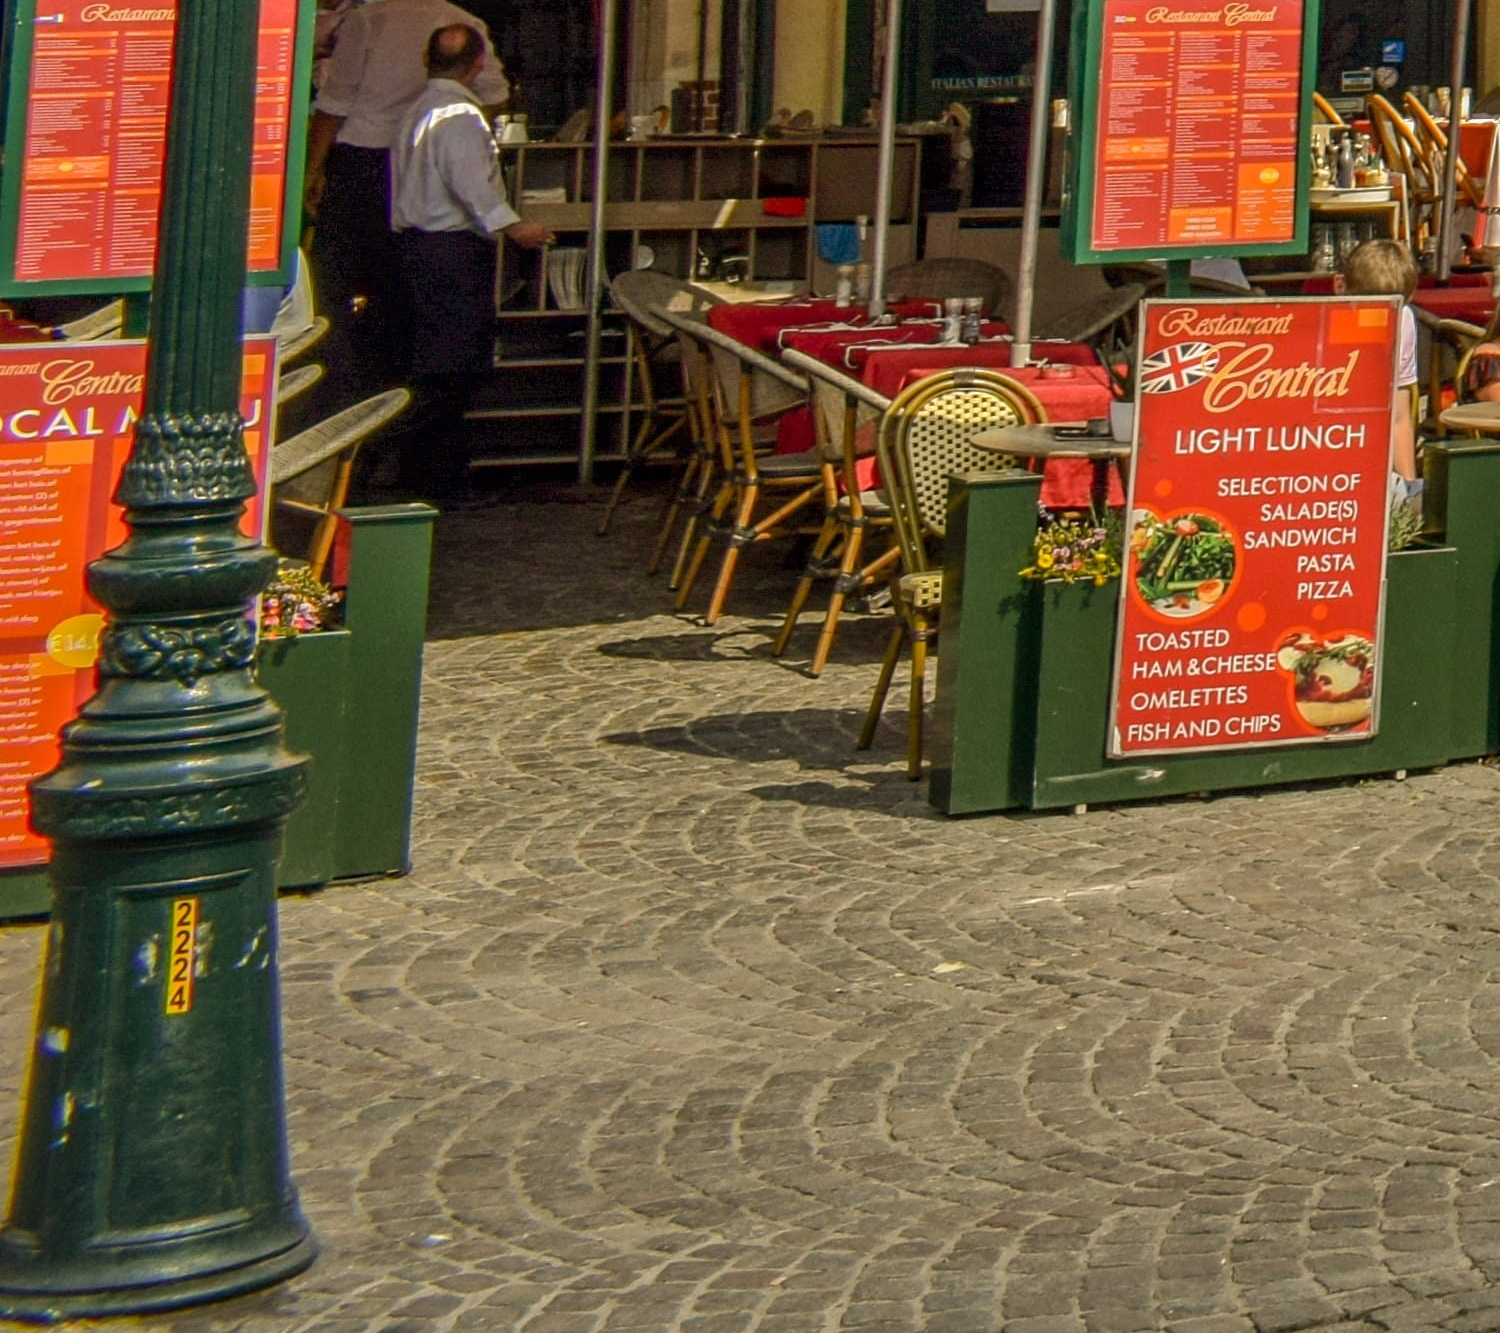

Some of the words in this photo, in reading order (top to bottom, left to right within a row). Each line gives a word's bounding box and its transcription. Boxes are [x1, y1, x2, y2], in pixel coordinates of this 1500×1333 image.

[1145, 7, 1221, 23] Restaurant
[1224, 3, 1278, 26] Central
[1159, 308, 1294, 337] Restaurant
[40, 359, 145, 405] Centra
[1200, 342, 1360, 413] Central
[1175, 427, 1261, 454] LIGHT
[1266, 424, 1365, 451] LUNCH
[1218, 475, 1327, 496] SELECTION
[1332, 474, 1361, 491] OF
[1260, 501, 1358, 521] SALADE(S)
[1244, 528, 1356, 549] SANDWICH
[1297, 554, 1355, 573] PASTA
[1297, 581, 1353, 599] PIZZA
[1136, 630, 1229, 651] TOASTED
[1133, 660, 1184, 679] HAM
[1131, 686, 1247, 710] OMELETTES
[1128, 722, 1170, 742] FISH
[1174, 719, 1221, 738] AND
[1225, 714, 1281, 735] CHIPS
[170, 901, 193, 1011] 2224
